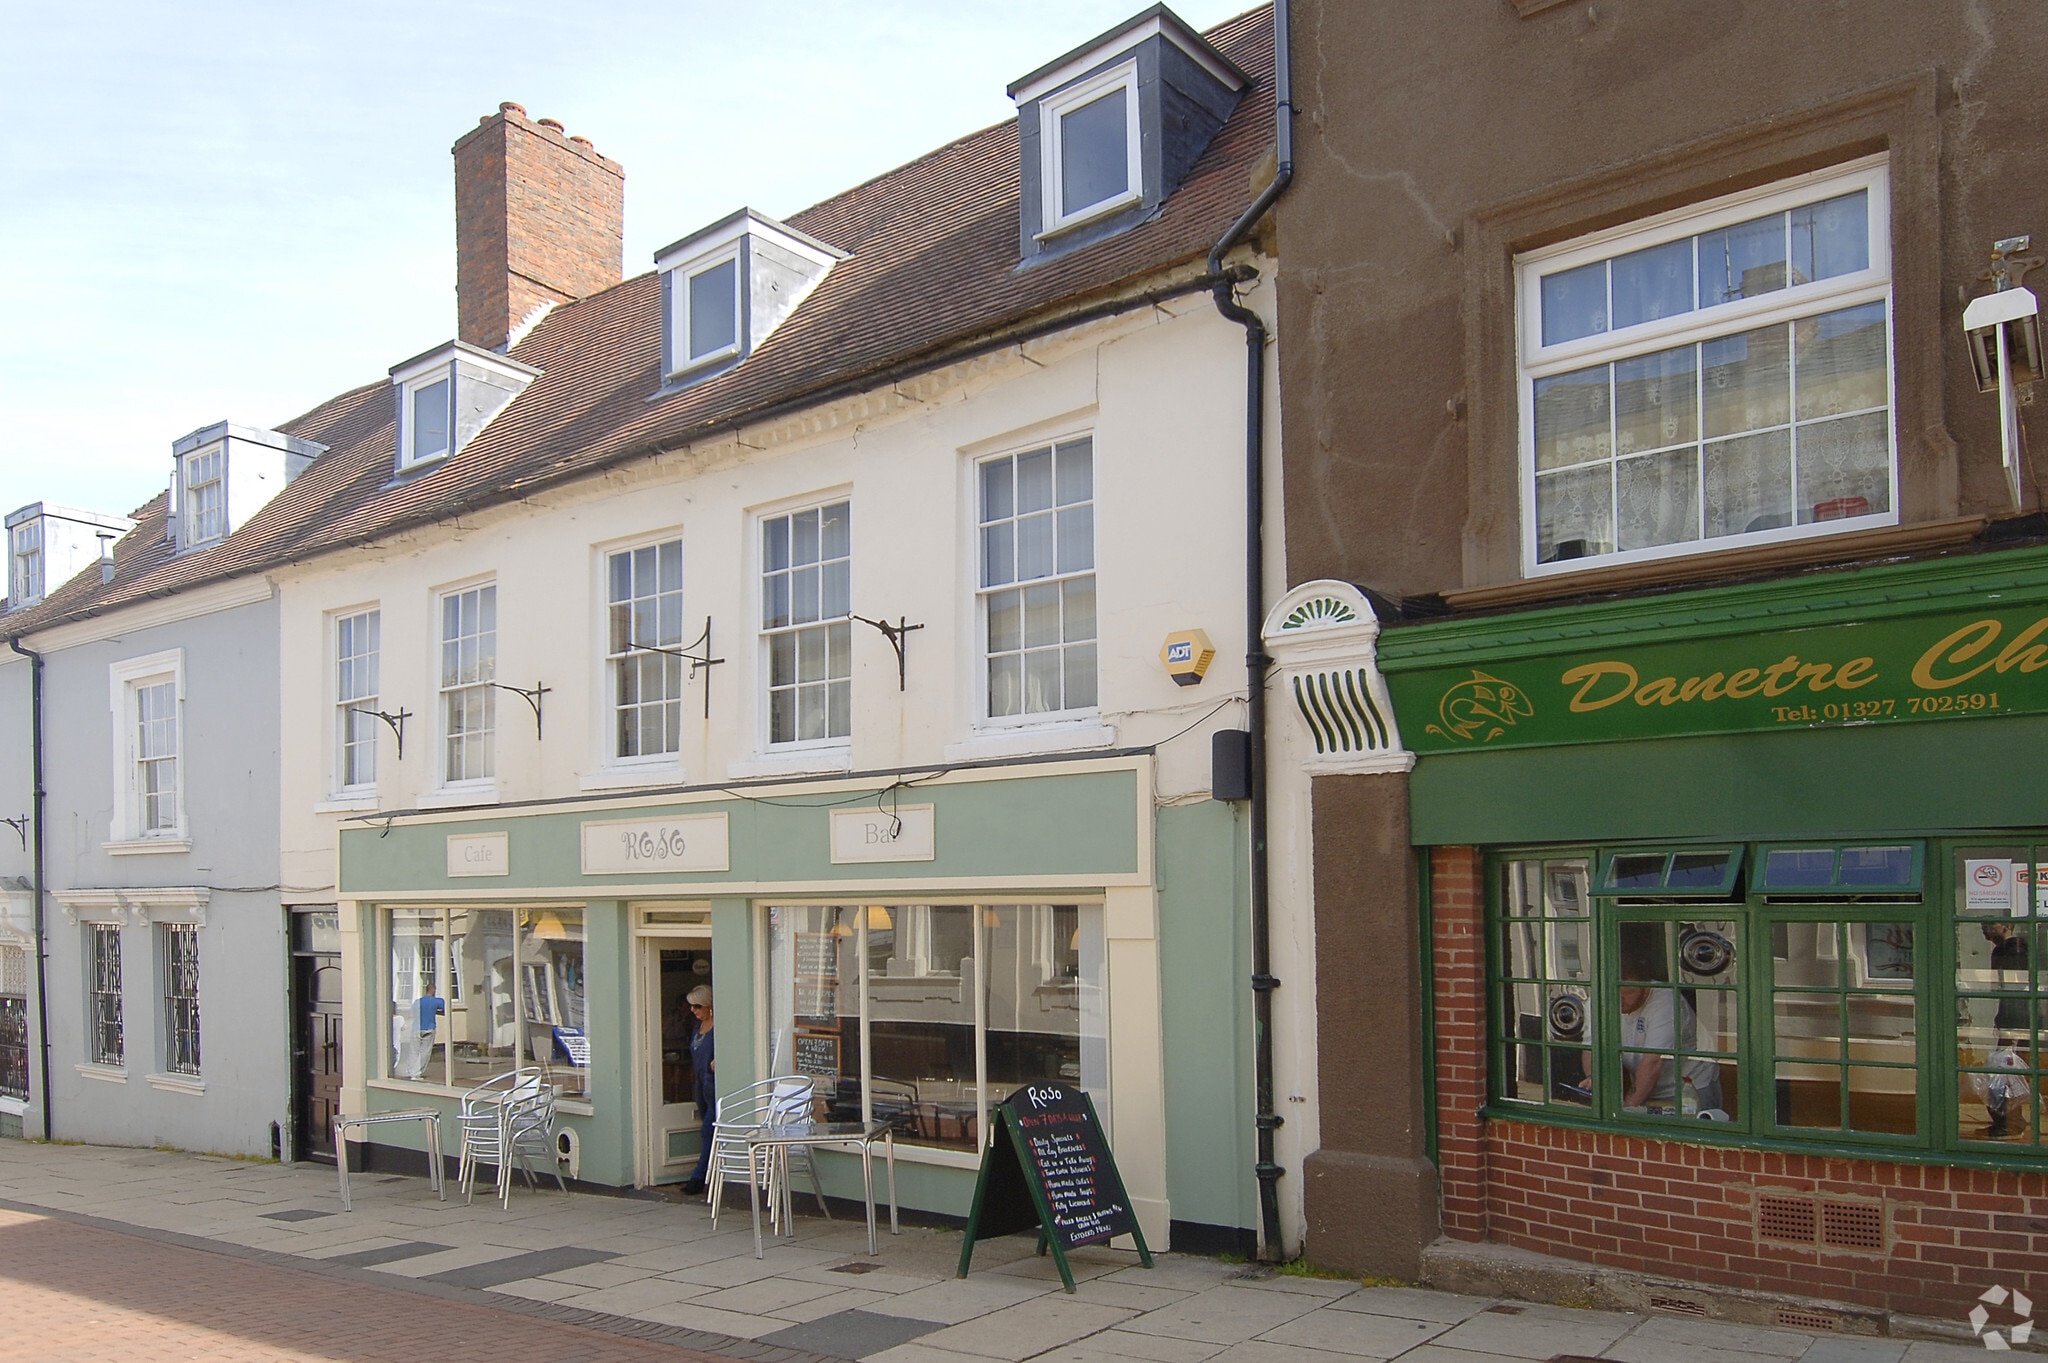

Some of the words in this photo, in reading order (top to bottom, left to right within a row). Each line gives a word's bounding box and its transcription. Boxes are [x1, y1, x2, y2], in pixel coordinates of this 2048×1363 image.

[1168, 645, 1192, 660] ADT
[1561, 655, 1878, 713] Danetre
[1771, 704, 1817, 722] Tel:
[1824, 699, 1896, 719] 01327
[1907, 692, 2000, 714] 702591
[464, 844, 493, 863] Cafe
